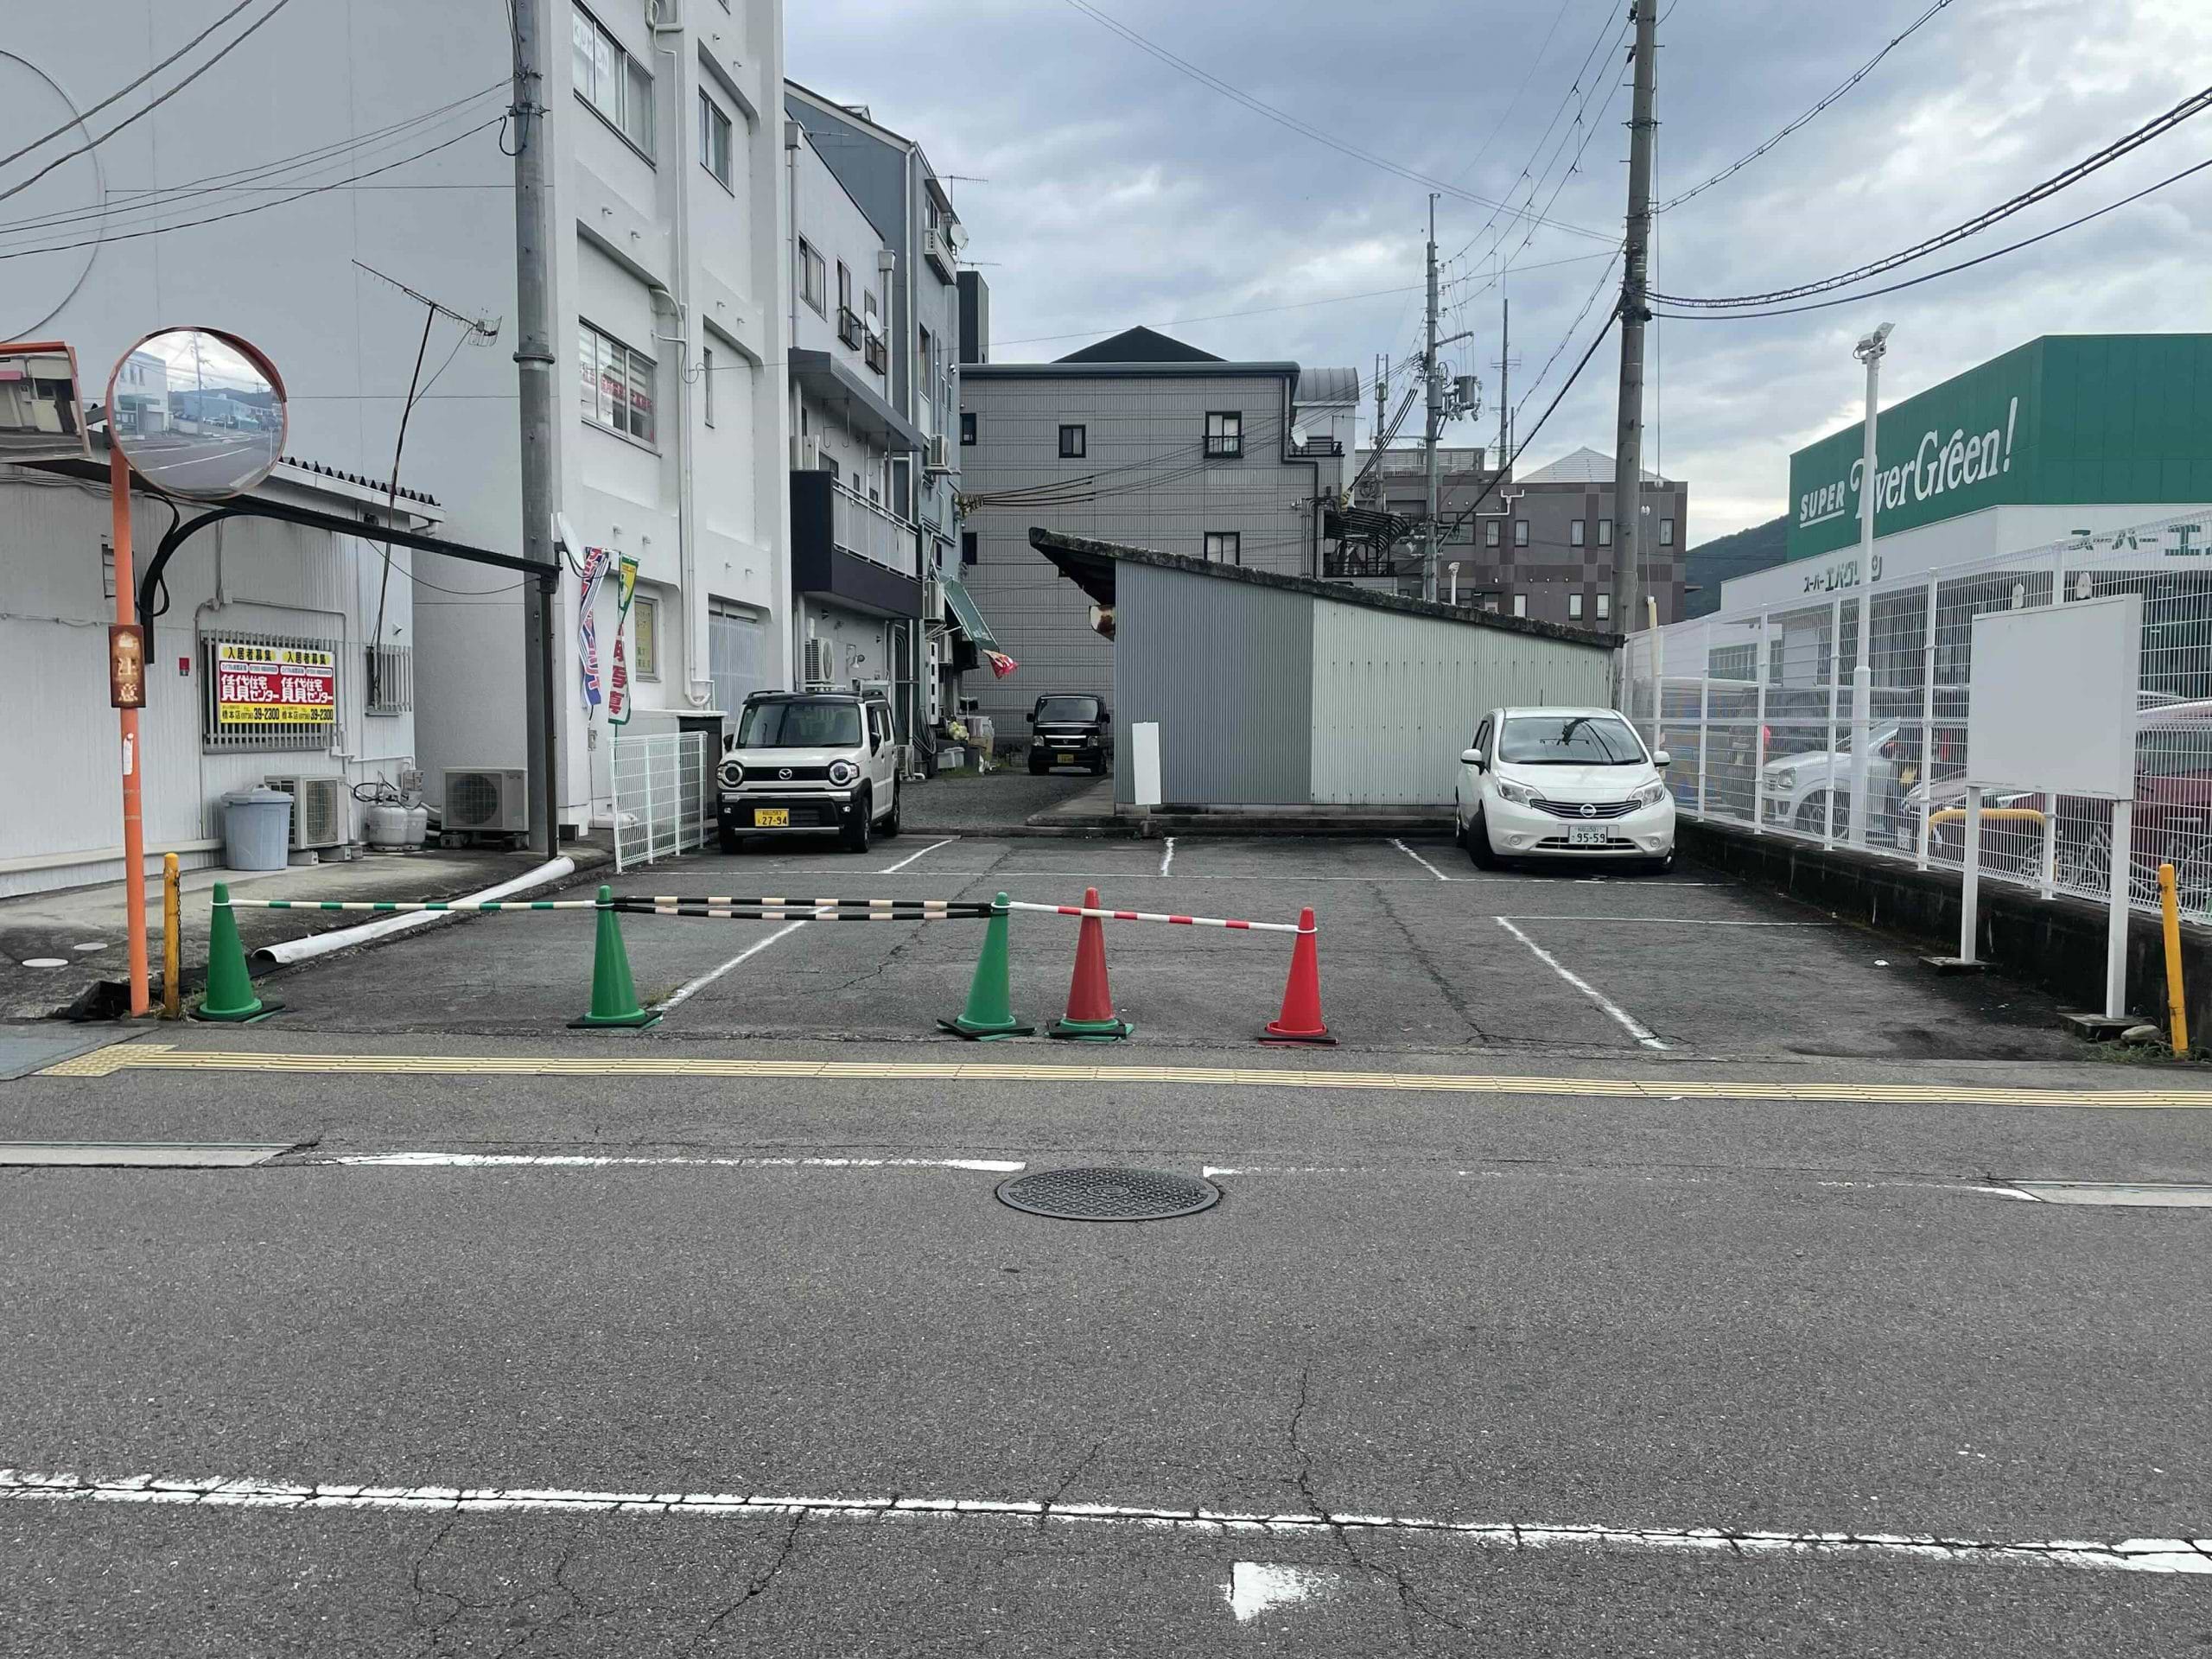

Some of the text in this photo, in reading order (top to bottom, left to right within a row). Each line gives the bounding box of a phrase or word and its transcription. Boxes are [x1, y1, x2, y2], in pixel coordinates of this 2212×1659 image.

[1800, 480, 1845, 522] SUPER
[2164, 524, 2212, 556] エ
[762, 816, 787, 825] 27-94
[1576, 833, 1605, 843] 95-59
